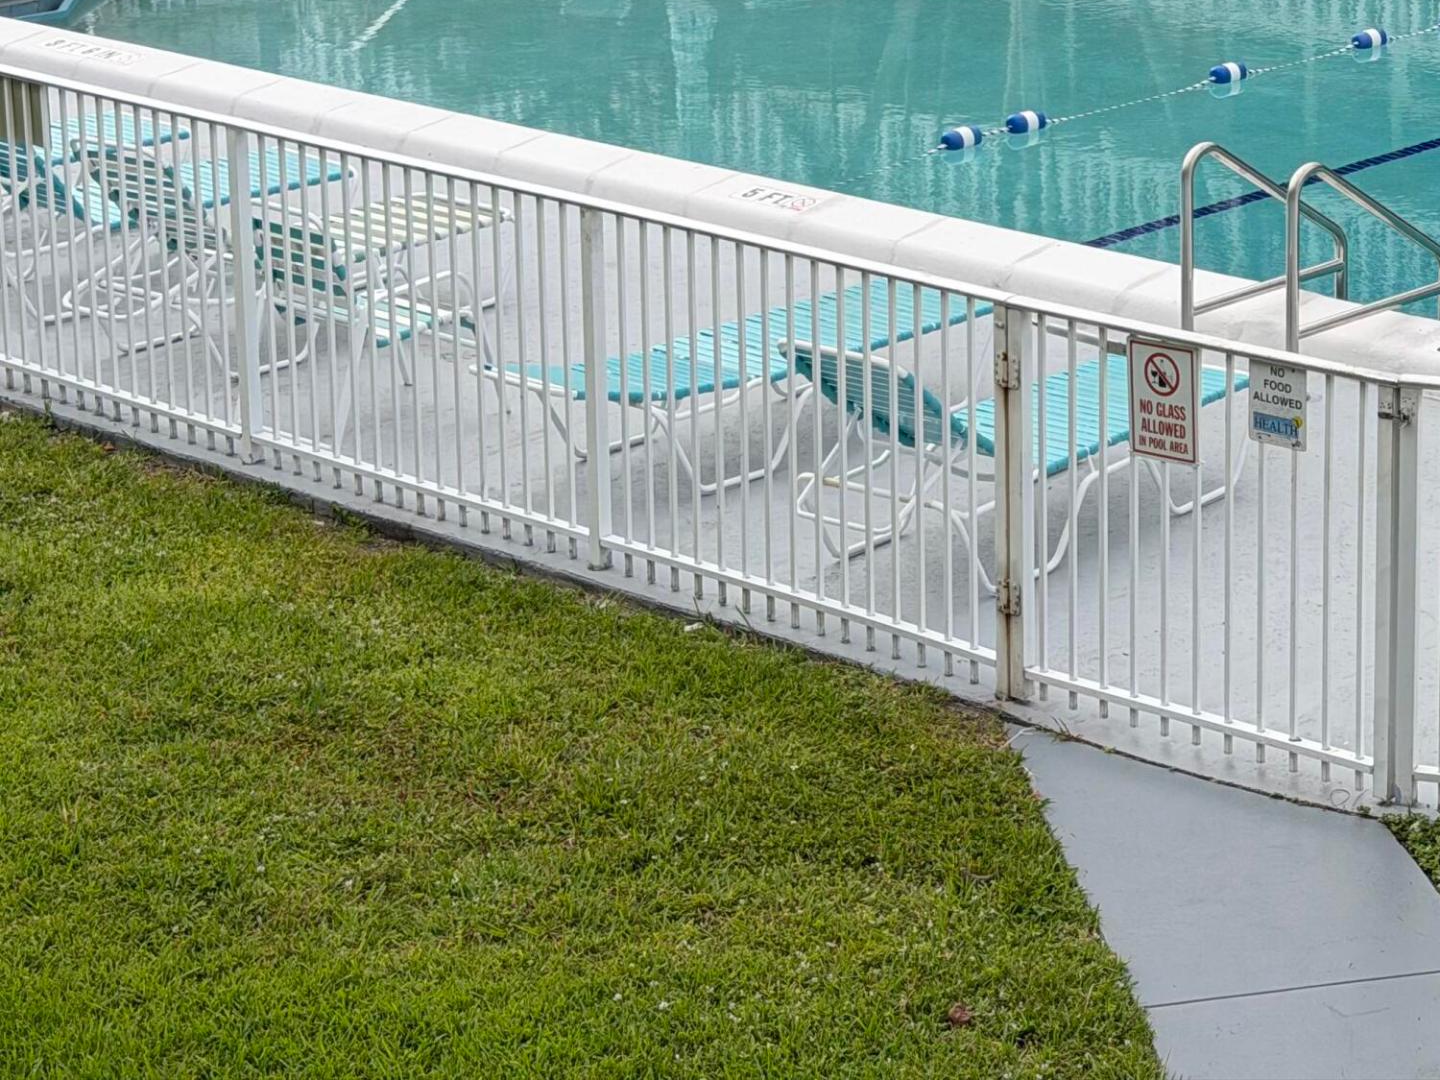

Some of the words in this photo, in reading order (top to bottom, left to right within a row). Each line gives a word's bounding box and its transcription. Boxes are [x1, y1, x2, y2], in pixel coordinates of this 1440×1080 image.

[1269, 366, 1285, 378] NO
[1263, 379, 1292, 394] FOOD
[1139, 398, 1153, 415] NO
[1156, 402, 1186, 421] GLASS
[1253, 391, 1303, 410] ALLOWED
[1141, 417, 1186, 439] ALLOWED
[1254, 416, 1299, 439] HEALTH
[1139, 435, 1147, 447] IN
[1148, 437, 1168, 451] POOL
[1169, 441, 1189, 455] AREA
